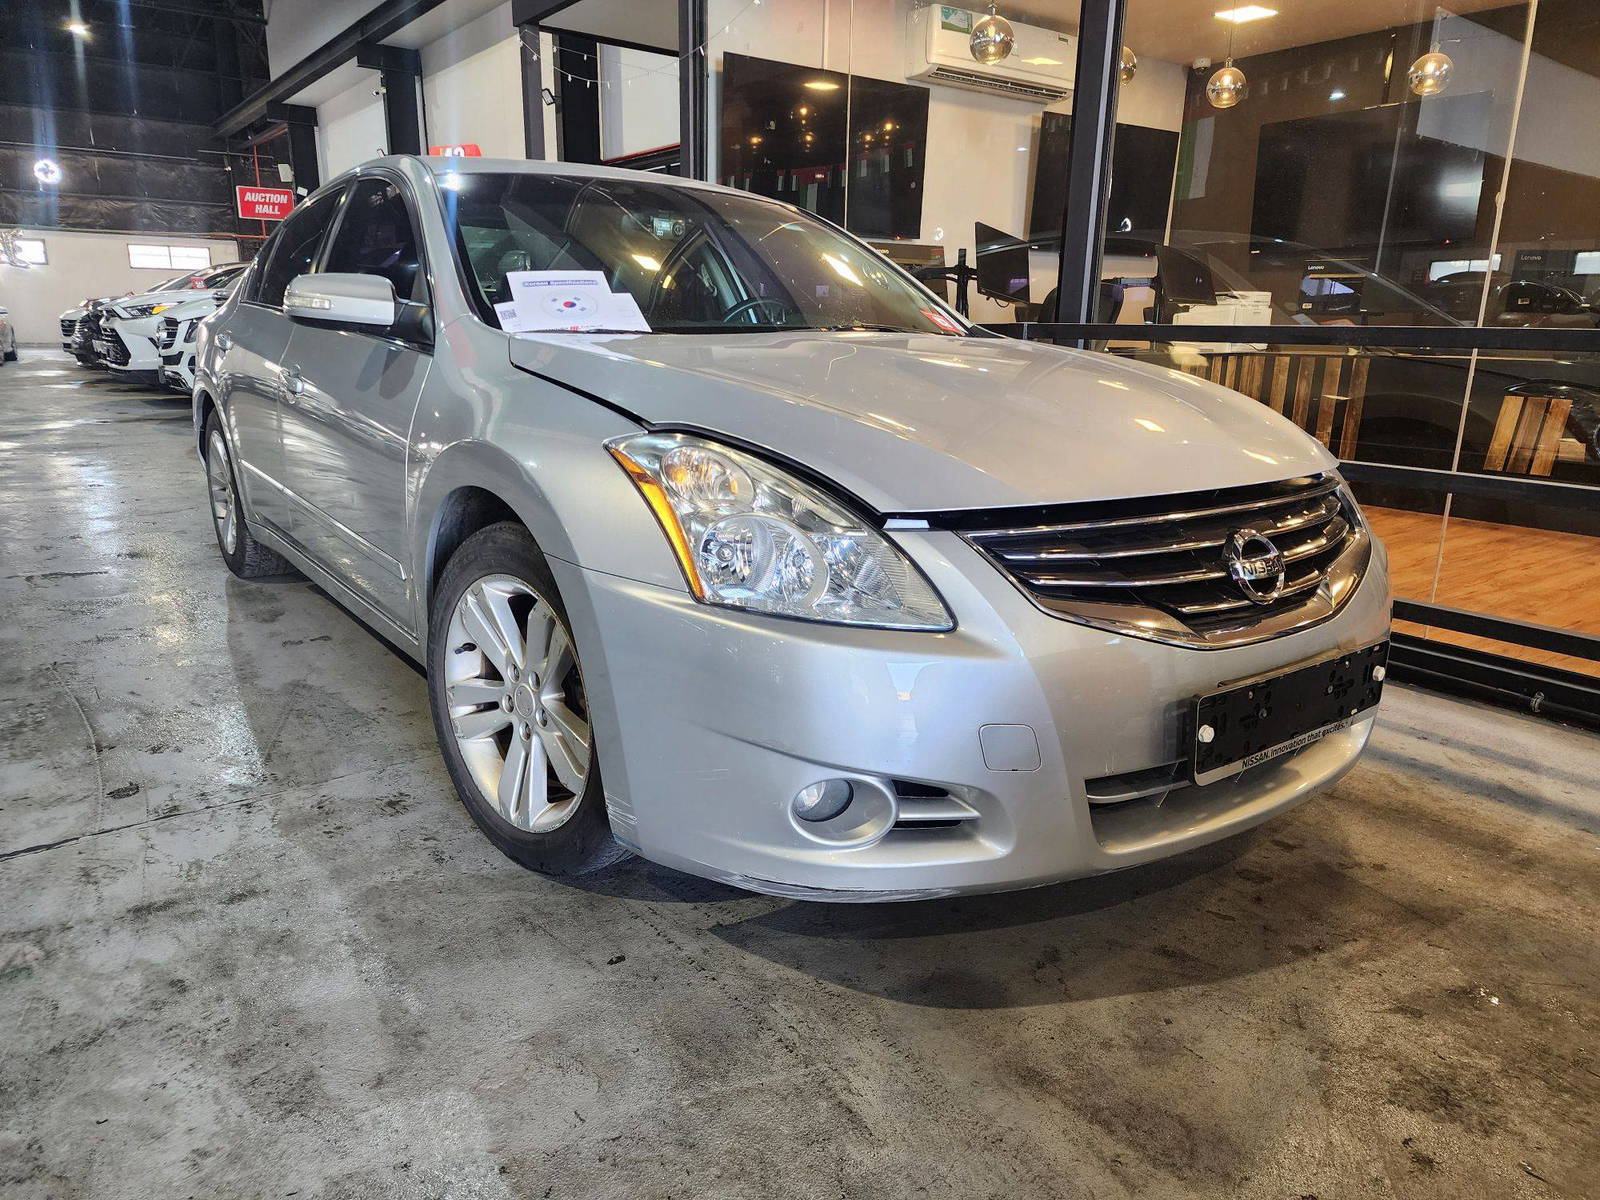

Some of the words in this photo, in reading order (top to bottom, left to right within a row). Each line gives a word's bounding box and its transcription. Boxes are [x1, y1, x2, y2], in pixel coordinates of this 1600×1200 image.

[244, 192, 288, 204] AUCTION
[255, 204, 281, 215] HALL
[1306, 730, 1322, 742] that
